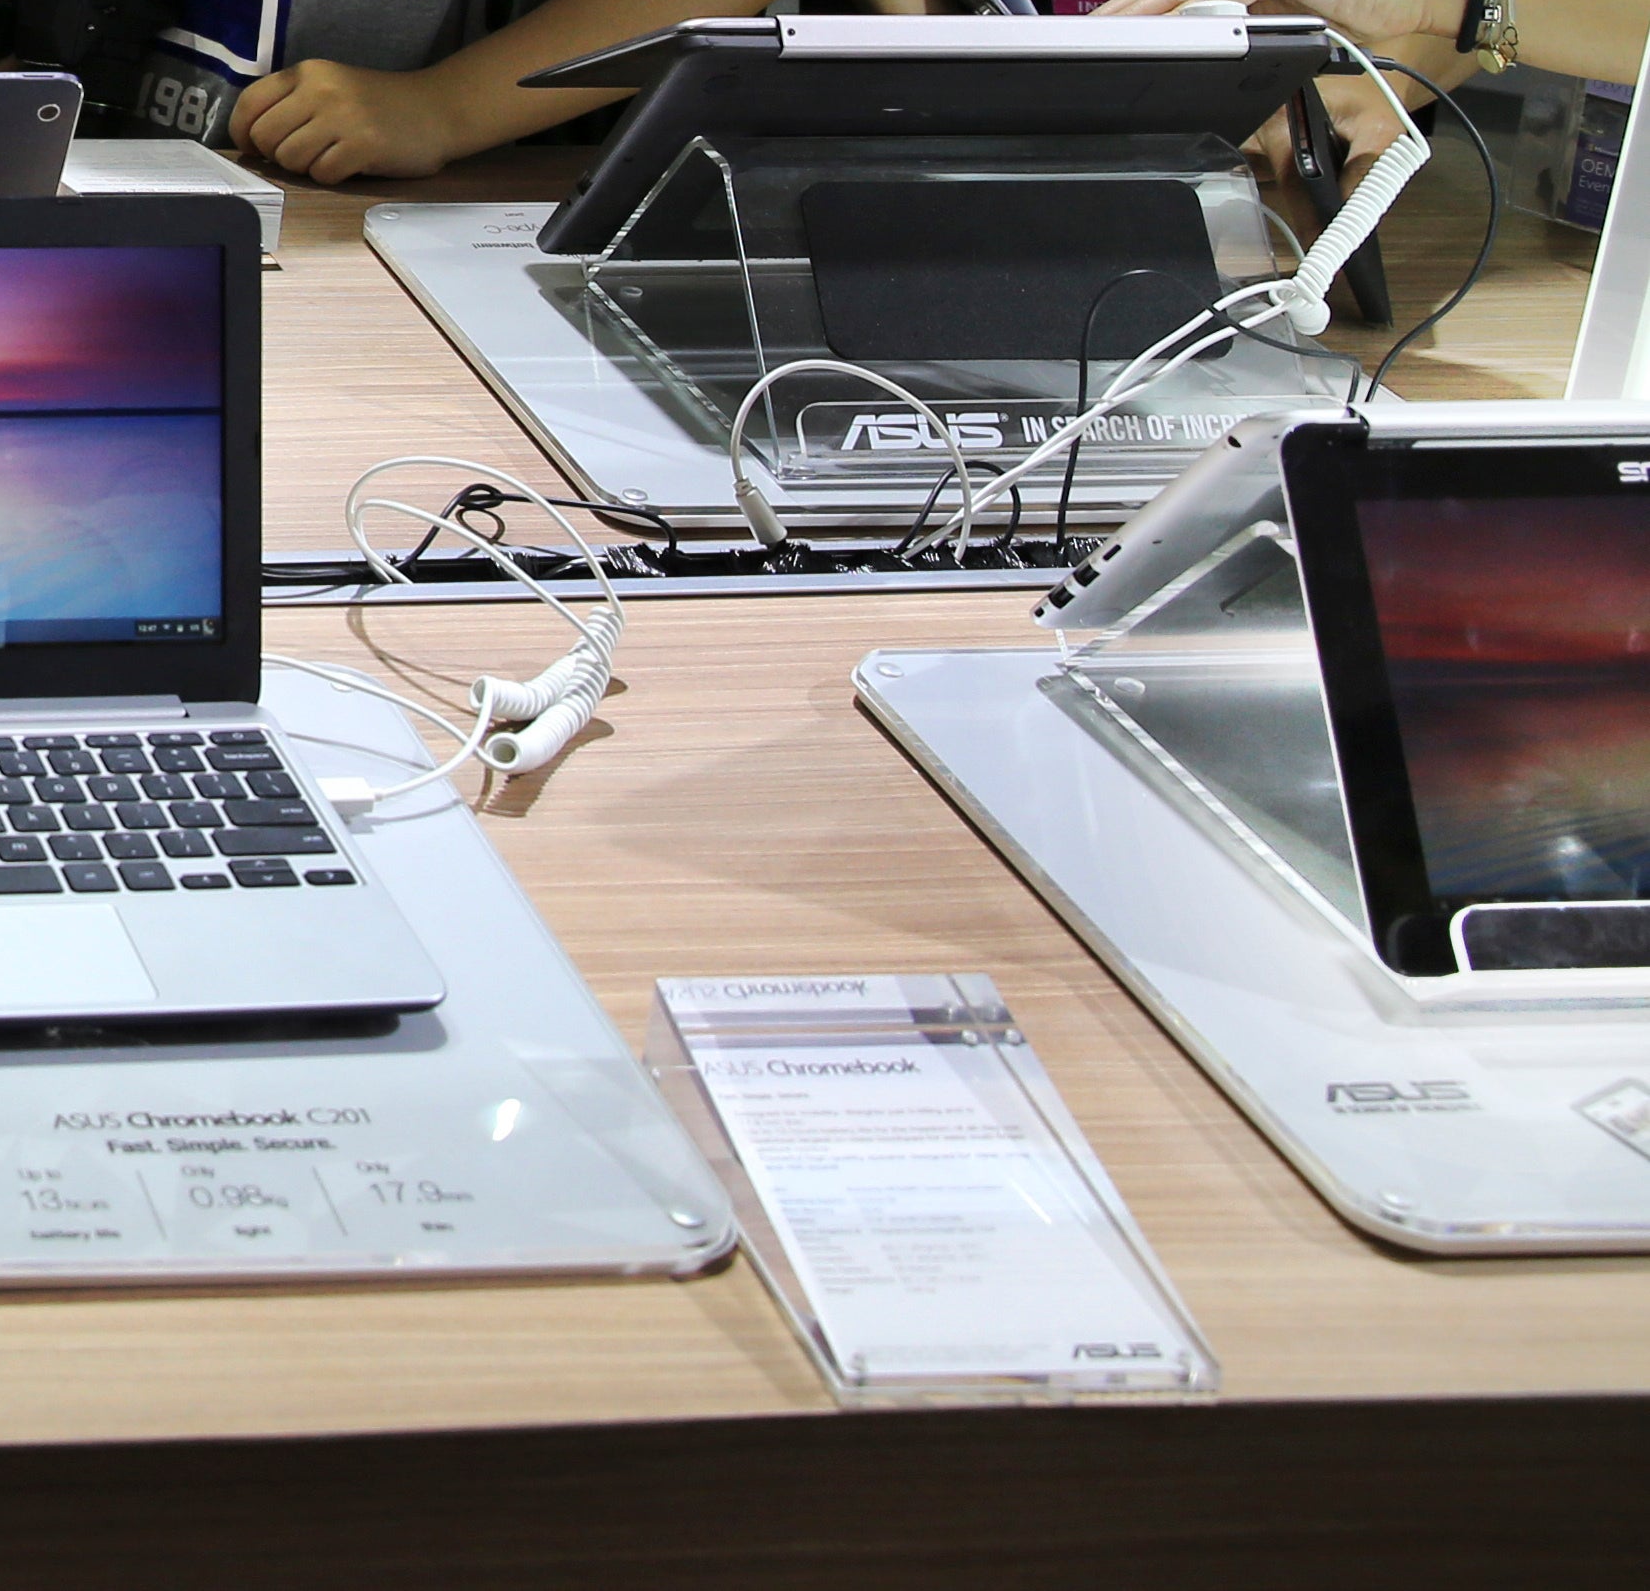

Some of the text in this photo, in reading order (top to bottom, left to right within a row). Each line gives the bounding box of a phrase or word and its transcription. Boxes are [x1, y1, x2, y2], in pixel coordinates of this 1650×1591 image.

[841, 412, 1002, 451] ASUS
[1021, 416, 1047, 443] IN
[1148, 414, 1175, 441] OF
[766, 1058, 920, 1077] Chromebook
[1326, 1081, 1471, 1103] ASUS
[53, 1107, 372, 1131] ASUS Chromebook C201
[106, 1136, 337, 1156] Fast. Simple. Secure.
[181, 1165, 215, 1179] Only
[356, 1160, 391, 1175] Only
[233, 1224, 271, 1238] light
